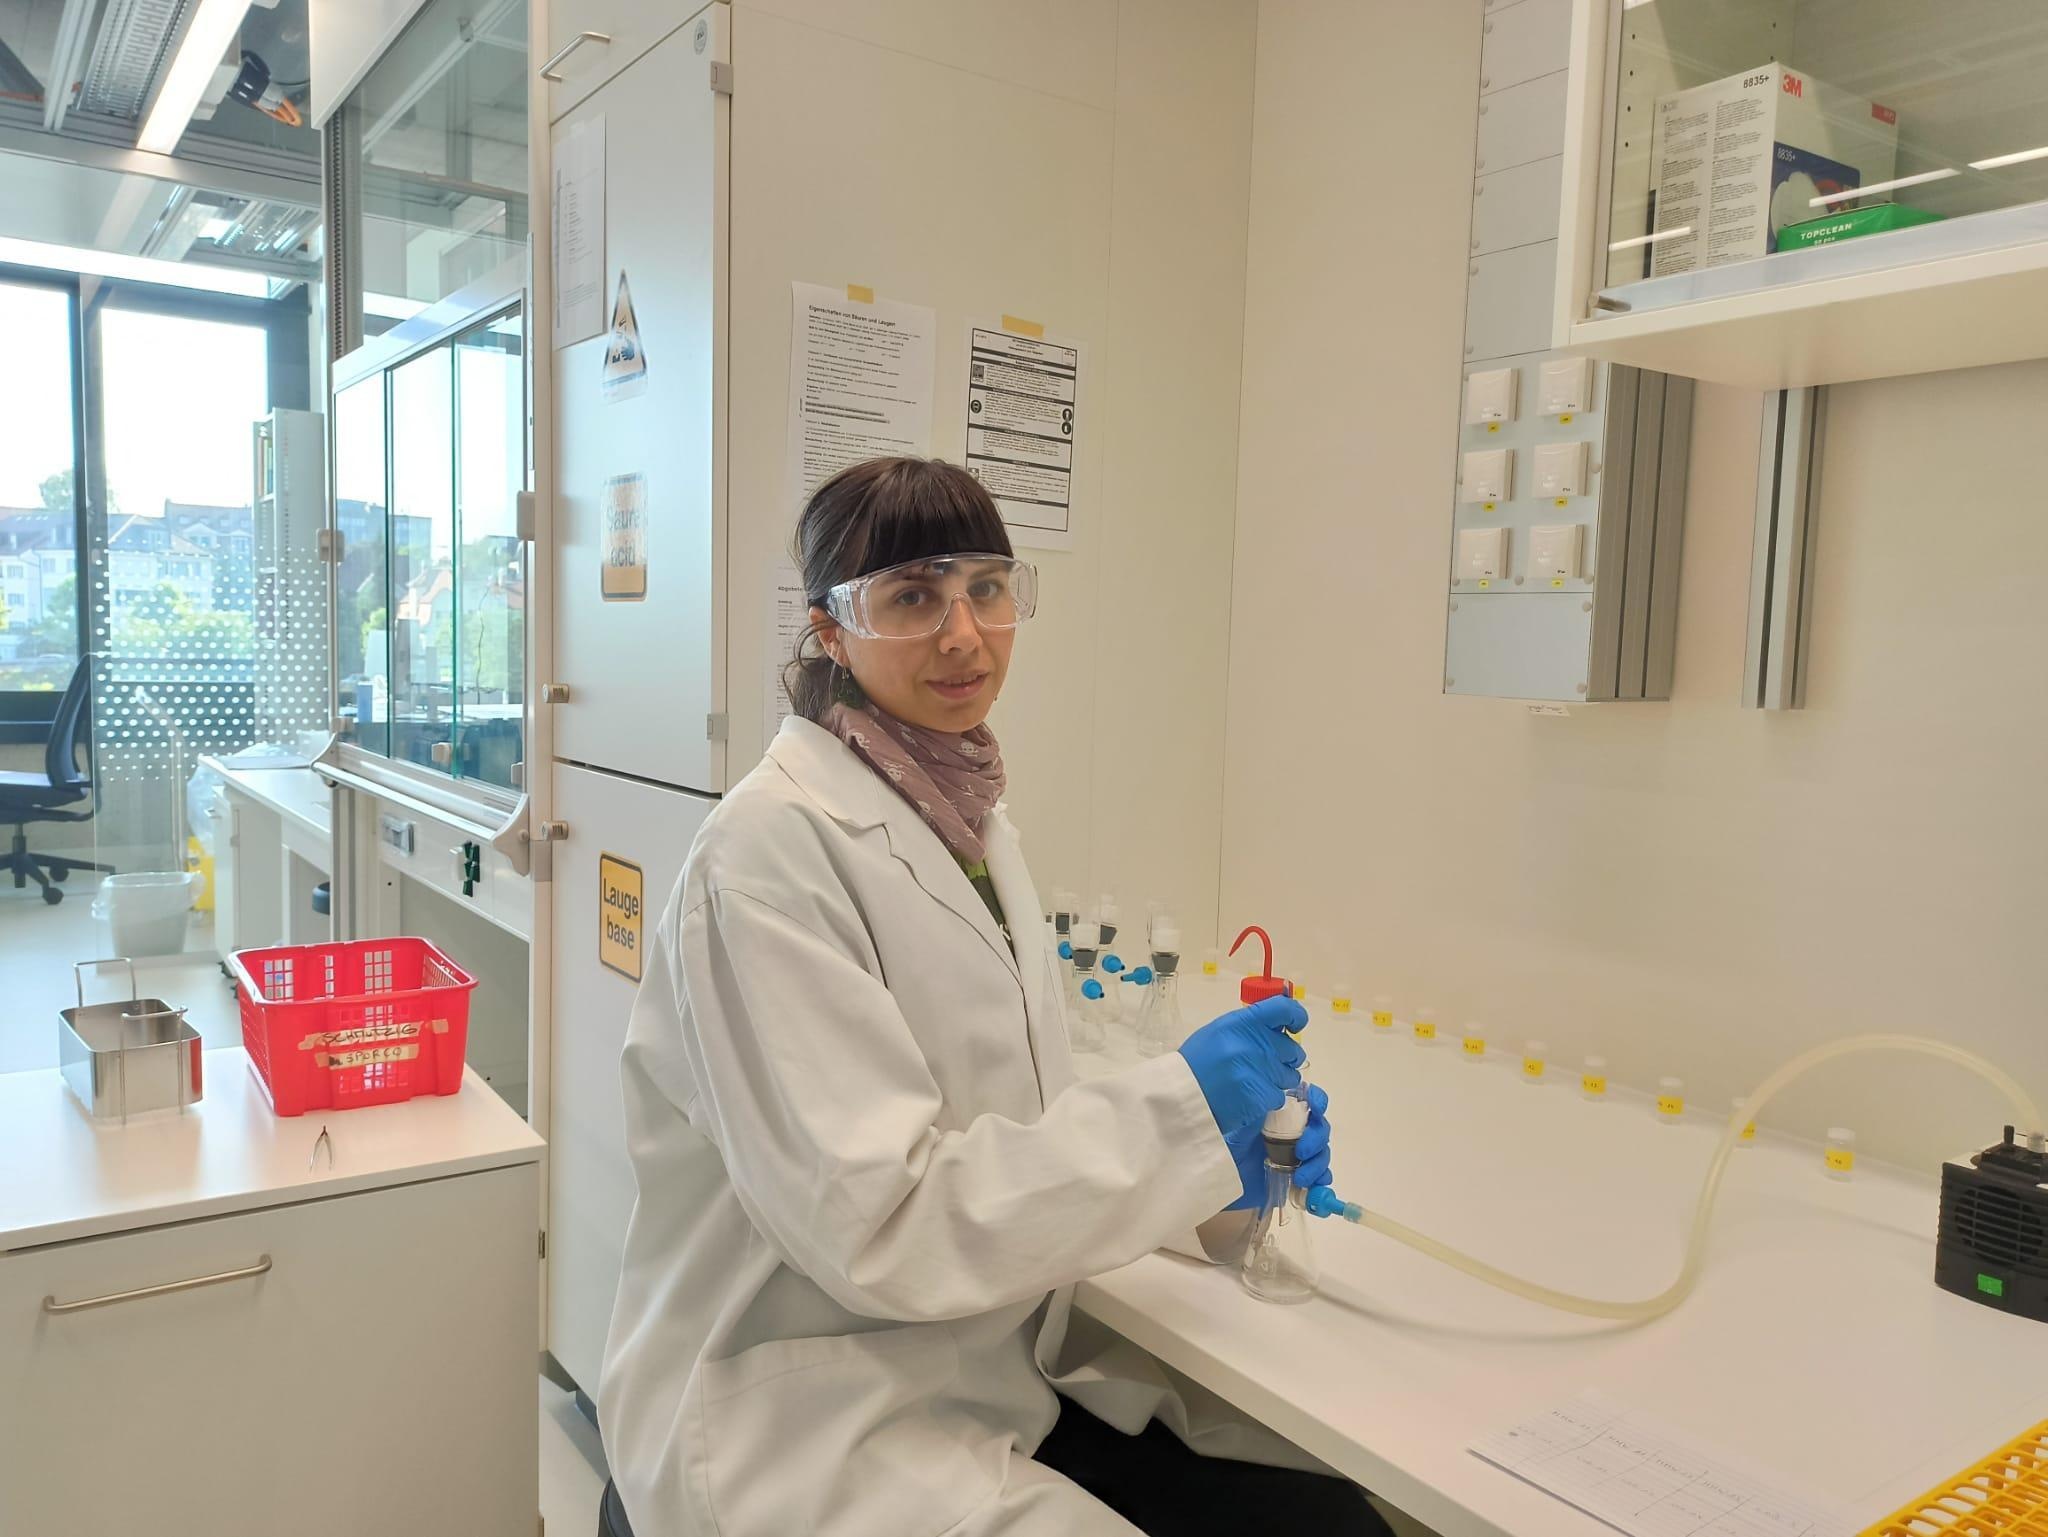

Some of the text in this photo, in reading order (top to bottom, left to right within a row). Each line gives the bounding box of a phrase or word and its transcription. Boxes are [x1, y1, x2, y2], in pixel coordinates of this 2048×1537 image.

[1743, 74, 1770, 89] 8835+
[1783, 73, 1802, 98] 3M
[1777, 147, 1796, 162] 8835+
[1800, 223, 1853, 240] TOPCLEAN
[603, 877, 638, 919] Lauge
[607, 914, 634, 950] base
[322, 1023, 417, 1043] SCHMUTZIG
[346, 1046, 402, 1062] SPORCO
